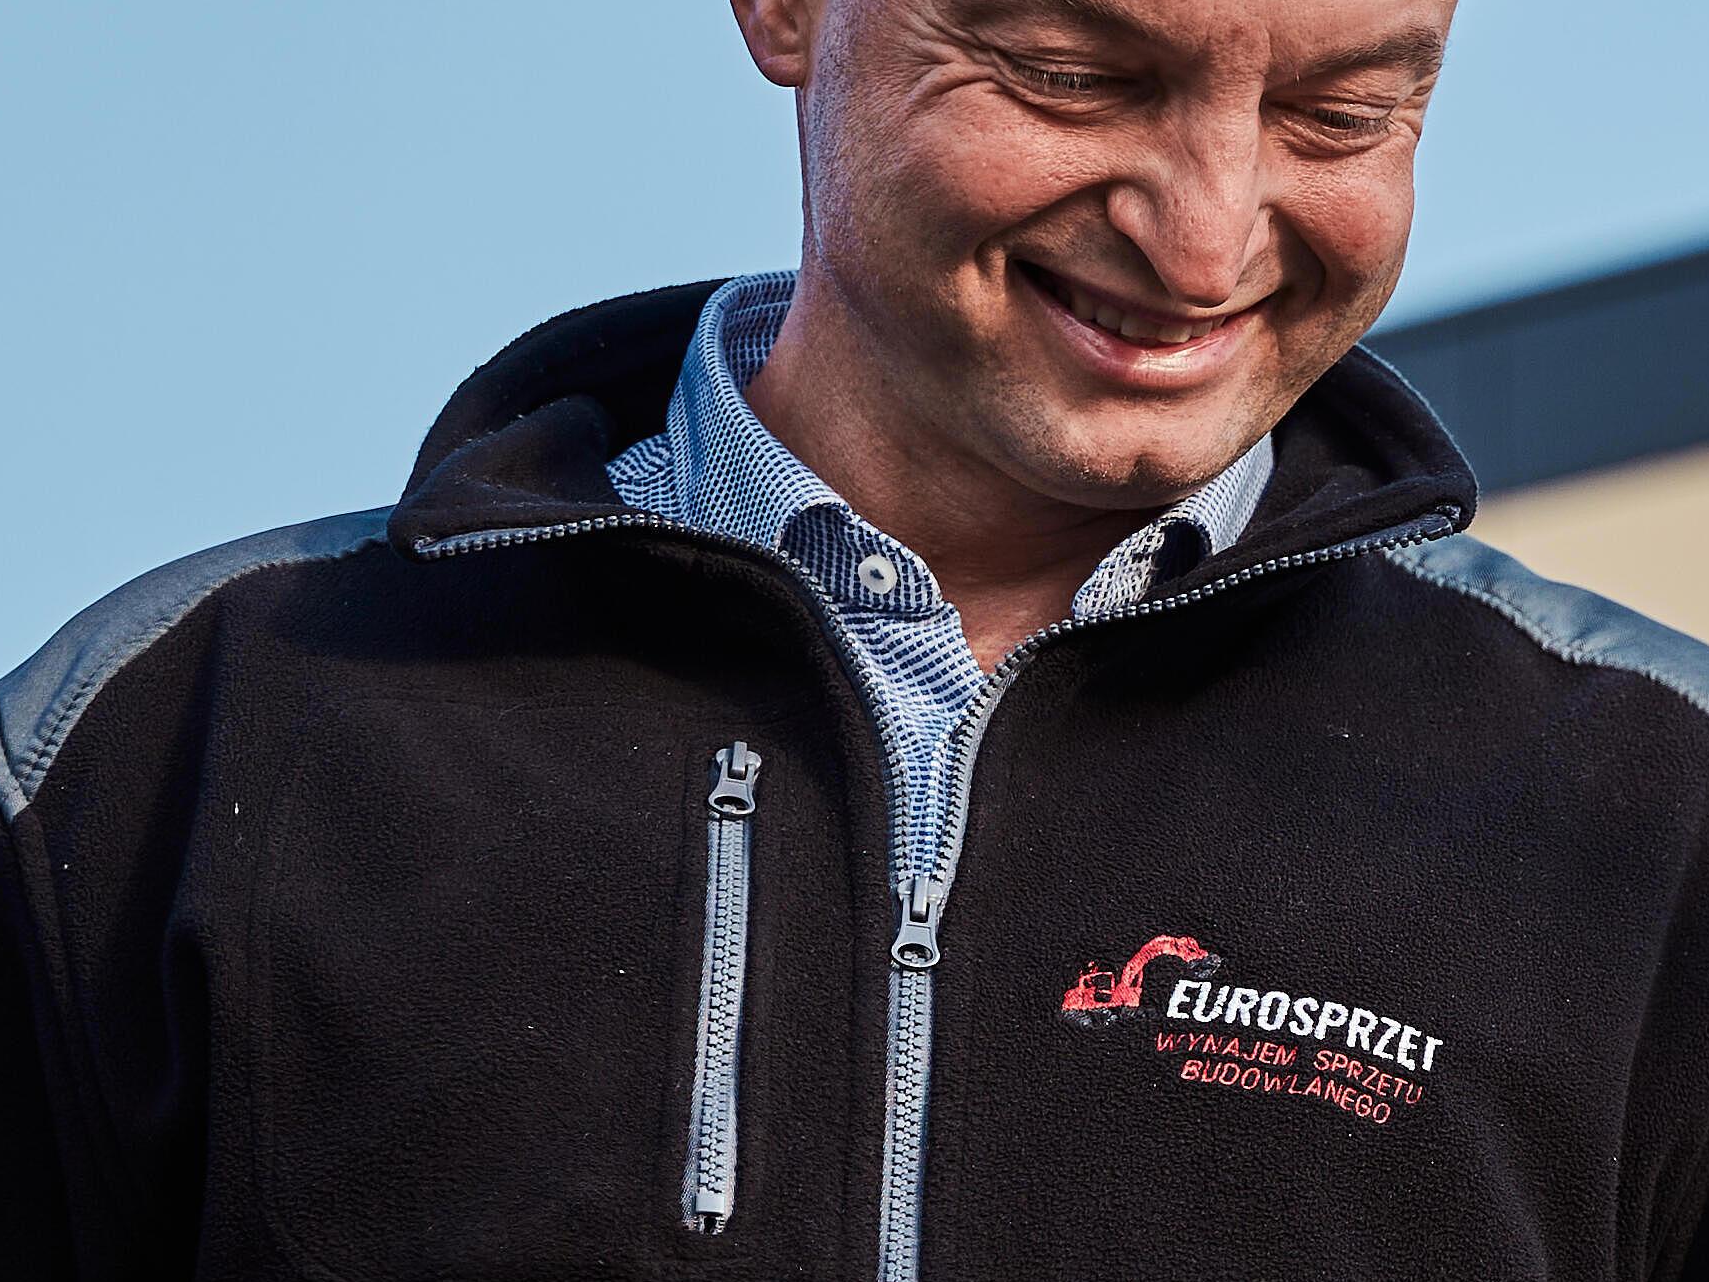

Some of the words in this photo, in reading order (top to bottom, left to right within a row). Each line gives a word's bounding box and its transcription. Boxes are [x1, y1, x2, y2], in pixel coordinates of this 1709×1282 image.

[1155, 1031, 1298, 1067] WYNAJEM
[1313, 1049, 1424, 1104] SPRZETU
[1180, 1059, 1391, 1124] BUDOWLANEGO
